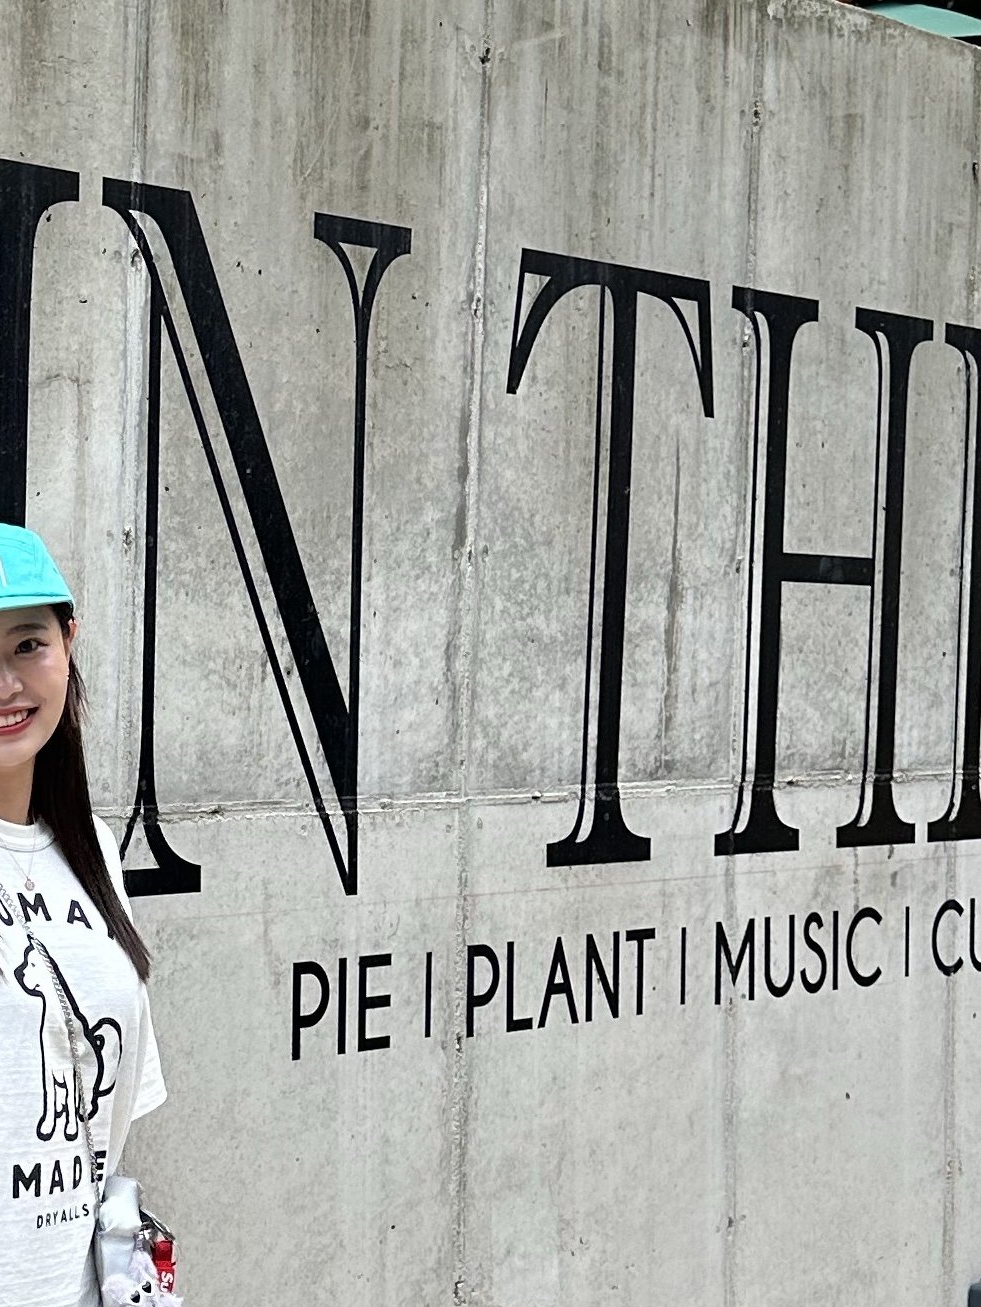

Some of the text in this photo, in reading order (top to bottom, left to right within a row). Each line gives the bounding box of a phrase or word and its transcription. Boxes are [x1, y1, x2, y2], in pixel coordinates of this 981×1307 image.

[291, 953, 392, 1061] PIE
[465, 927, 656, 1038] PLANT
[714, 906, 883, 1006] MUSIC
[12, 1150, 107, 1199] MADE
